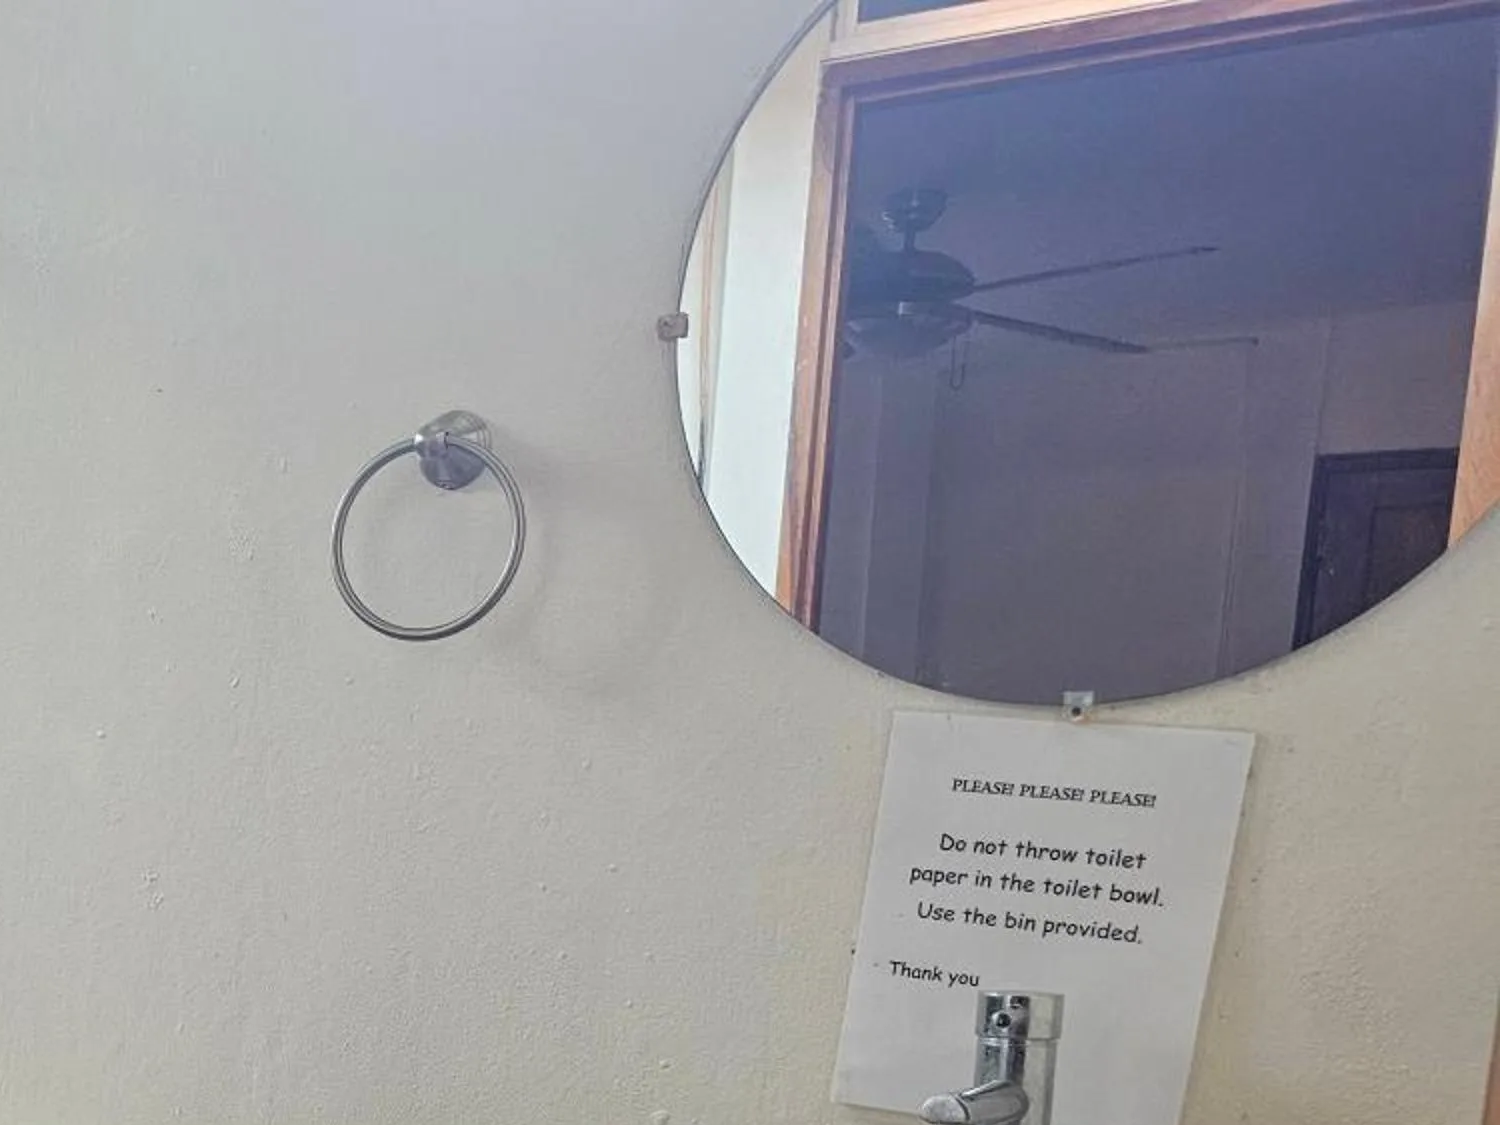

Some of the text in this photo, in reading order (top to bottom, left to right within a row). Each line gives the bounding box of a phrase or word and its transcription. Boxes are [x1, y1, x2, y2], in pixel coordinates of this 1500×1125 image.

[952, 778, 1157, 808] PLEASE! PLEASE! PLEASE!
[939, 833, 1147, 869] Do not throw toilet
[909, 867, 1165, 907] paper in the toilet bowl.
[917, 901, 1143, 945] Use the bin provided.
[889, 960, 980, 988] Thank you
